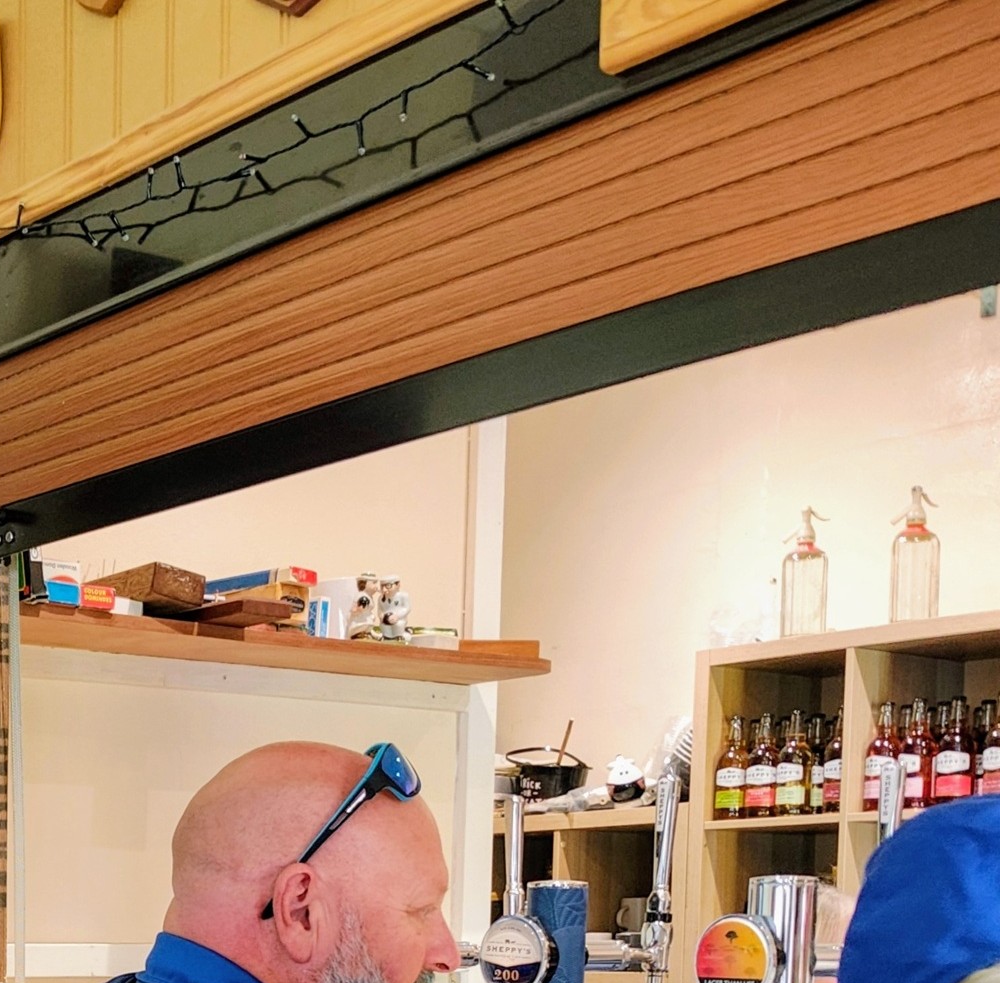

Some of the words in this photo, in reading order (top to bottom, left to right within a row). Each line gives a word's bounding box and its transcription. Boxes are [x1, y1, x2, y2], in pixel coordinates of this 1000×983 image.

[83, 587, 106, 596] COLOUR
[486, 945, 532, 955] SHEPPY'S
[492, 969, 520, 981] 200
